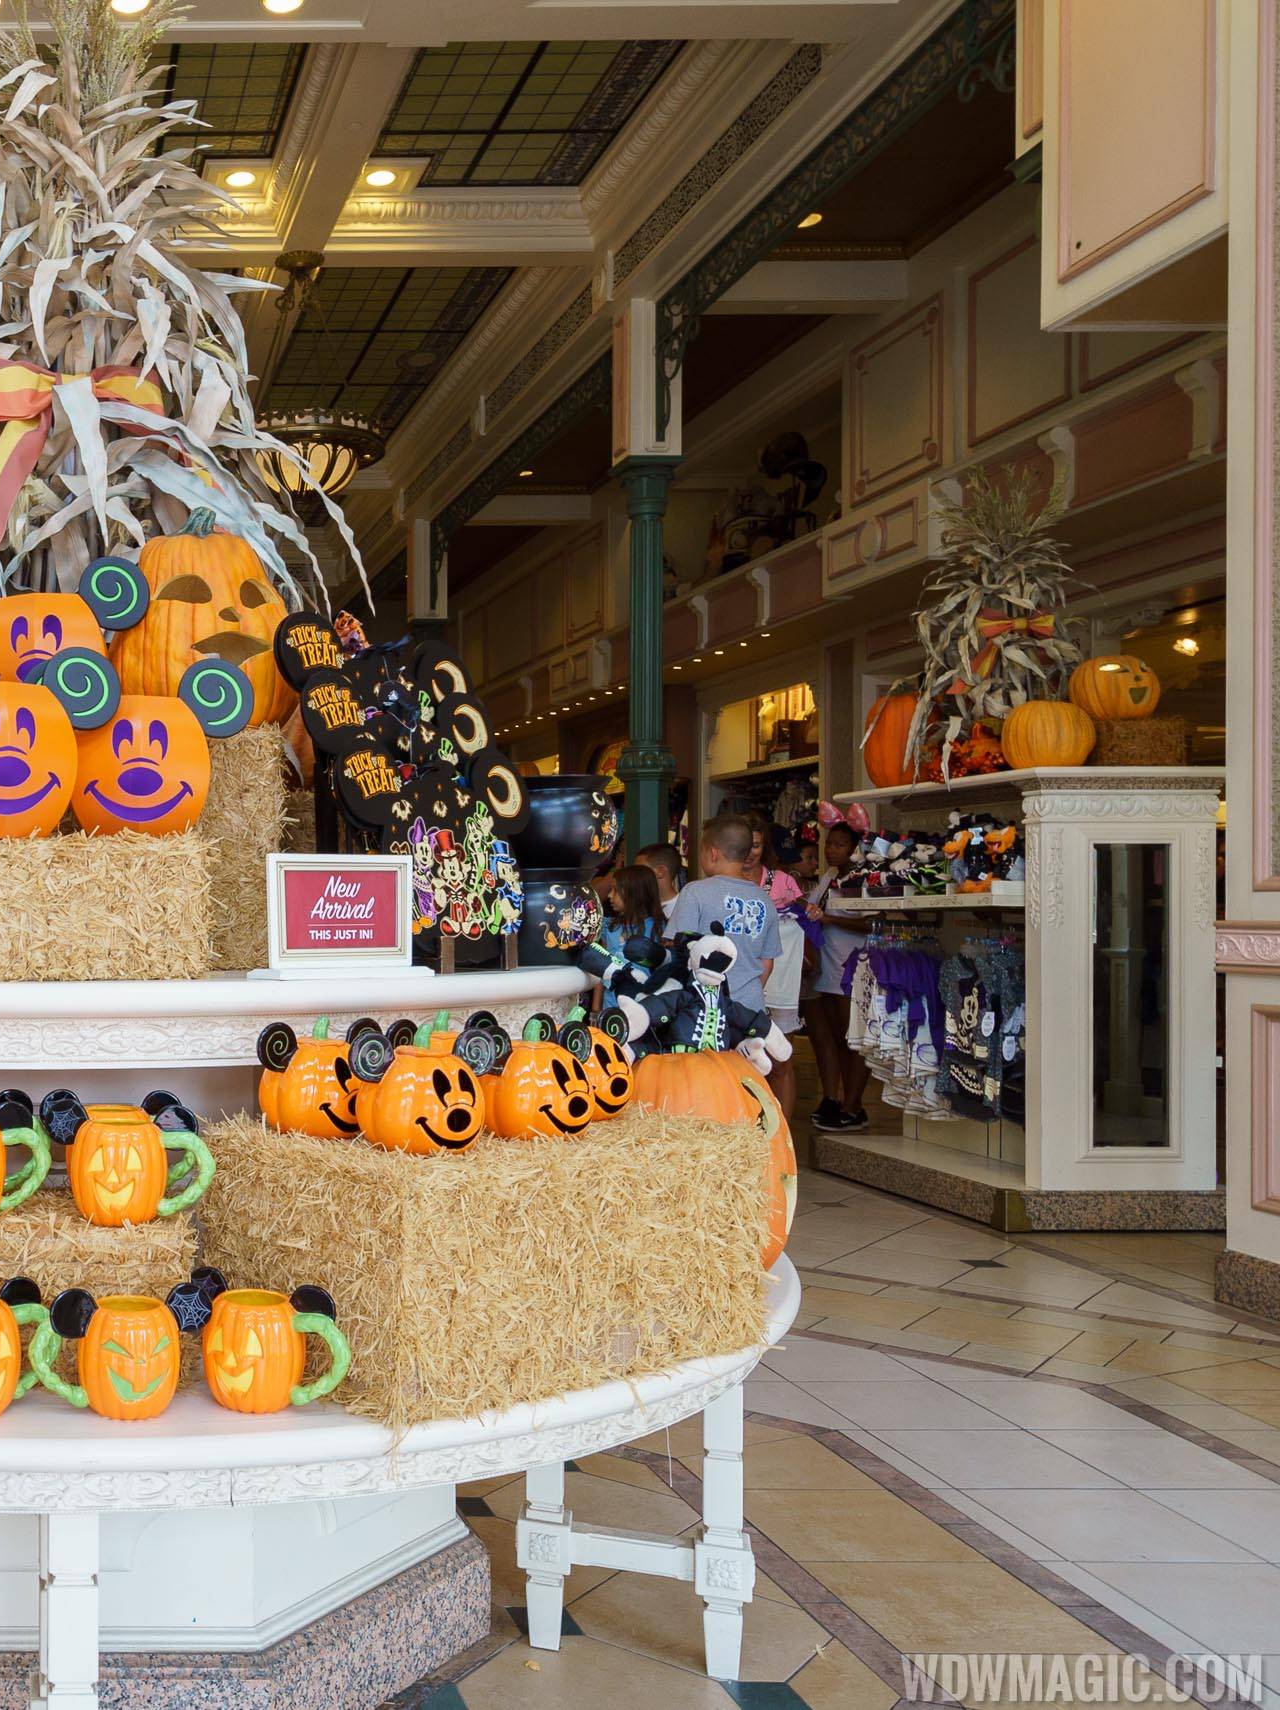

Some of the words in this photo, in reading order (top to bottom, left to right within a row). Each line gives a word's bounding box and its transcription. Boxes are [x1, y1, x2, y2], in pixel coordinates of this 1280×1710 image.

[288, 624, 318, 647] TRICK
[321, 630, 331, 644] OR
[298, 642, 338, 668] TREAT
[308, 684, 338, 708] TRICK
[319, 701, 361, 730] TREAT
[345, 751, 375, 777] TRICK
[356, 768, 396, 798] TREAT
[323, 875, 362, 898] New
[310, 896, 376, 920] Arrival
[308, 929, 331, 940] THIS
[333, 929, 358, 940] JUST
[359, 929, 374, 940] IN!
